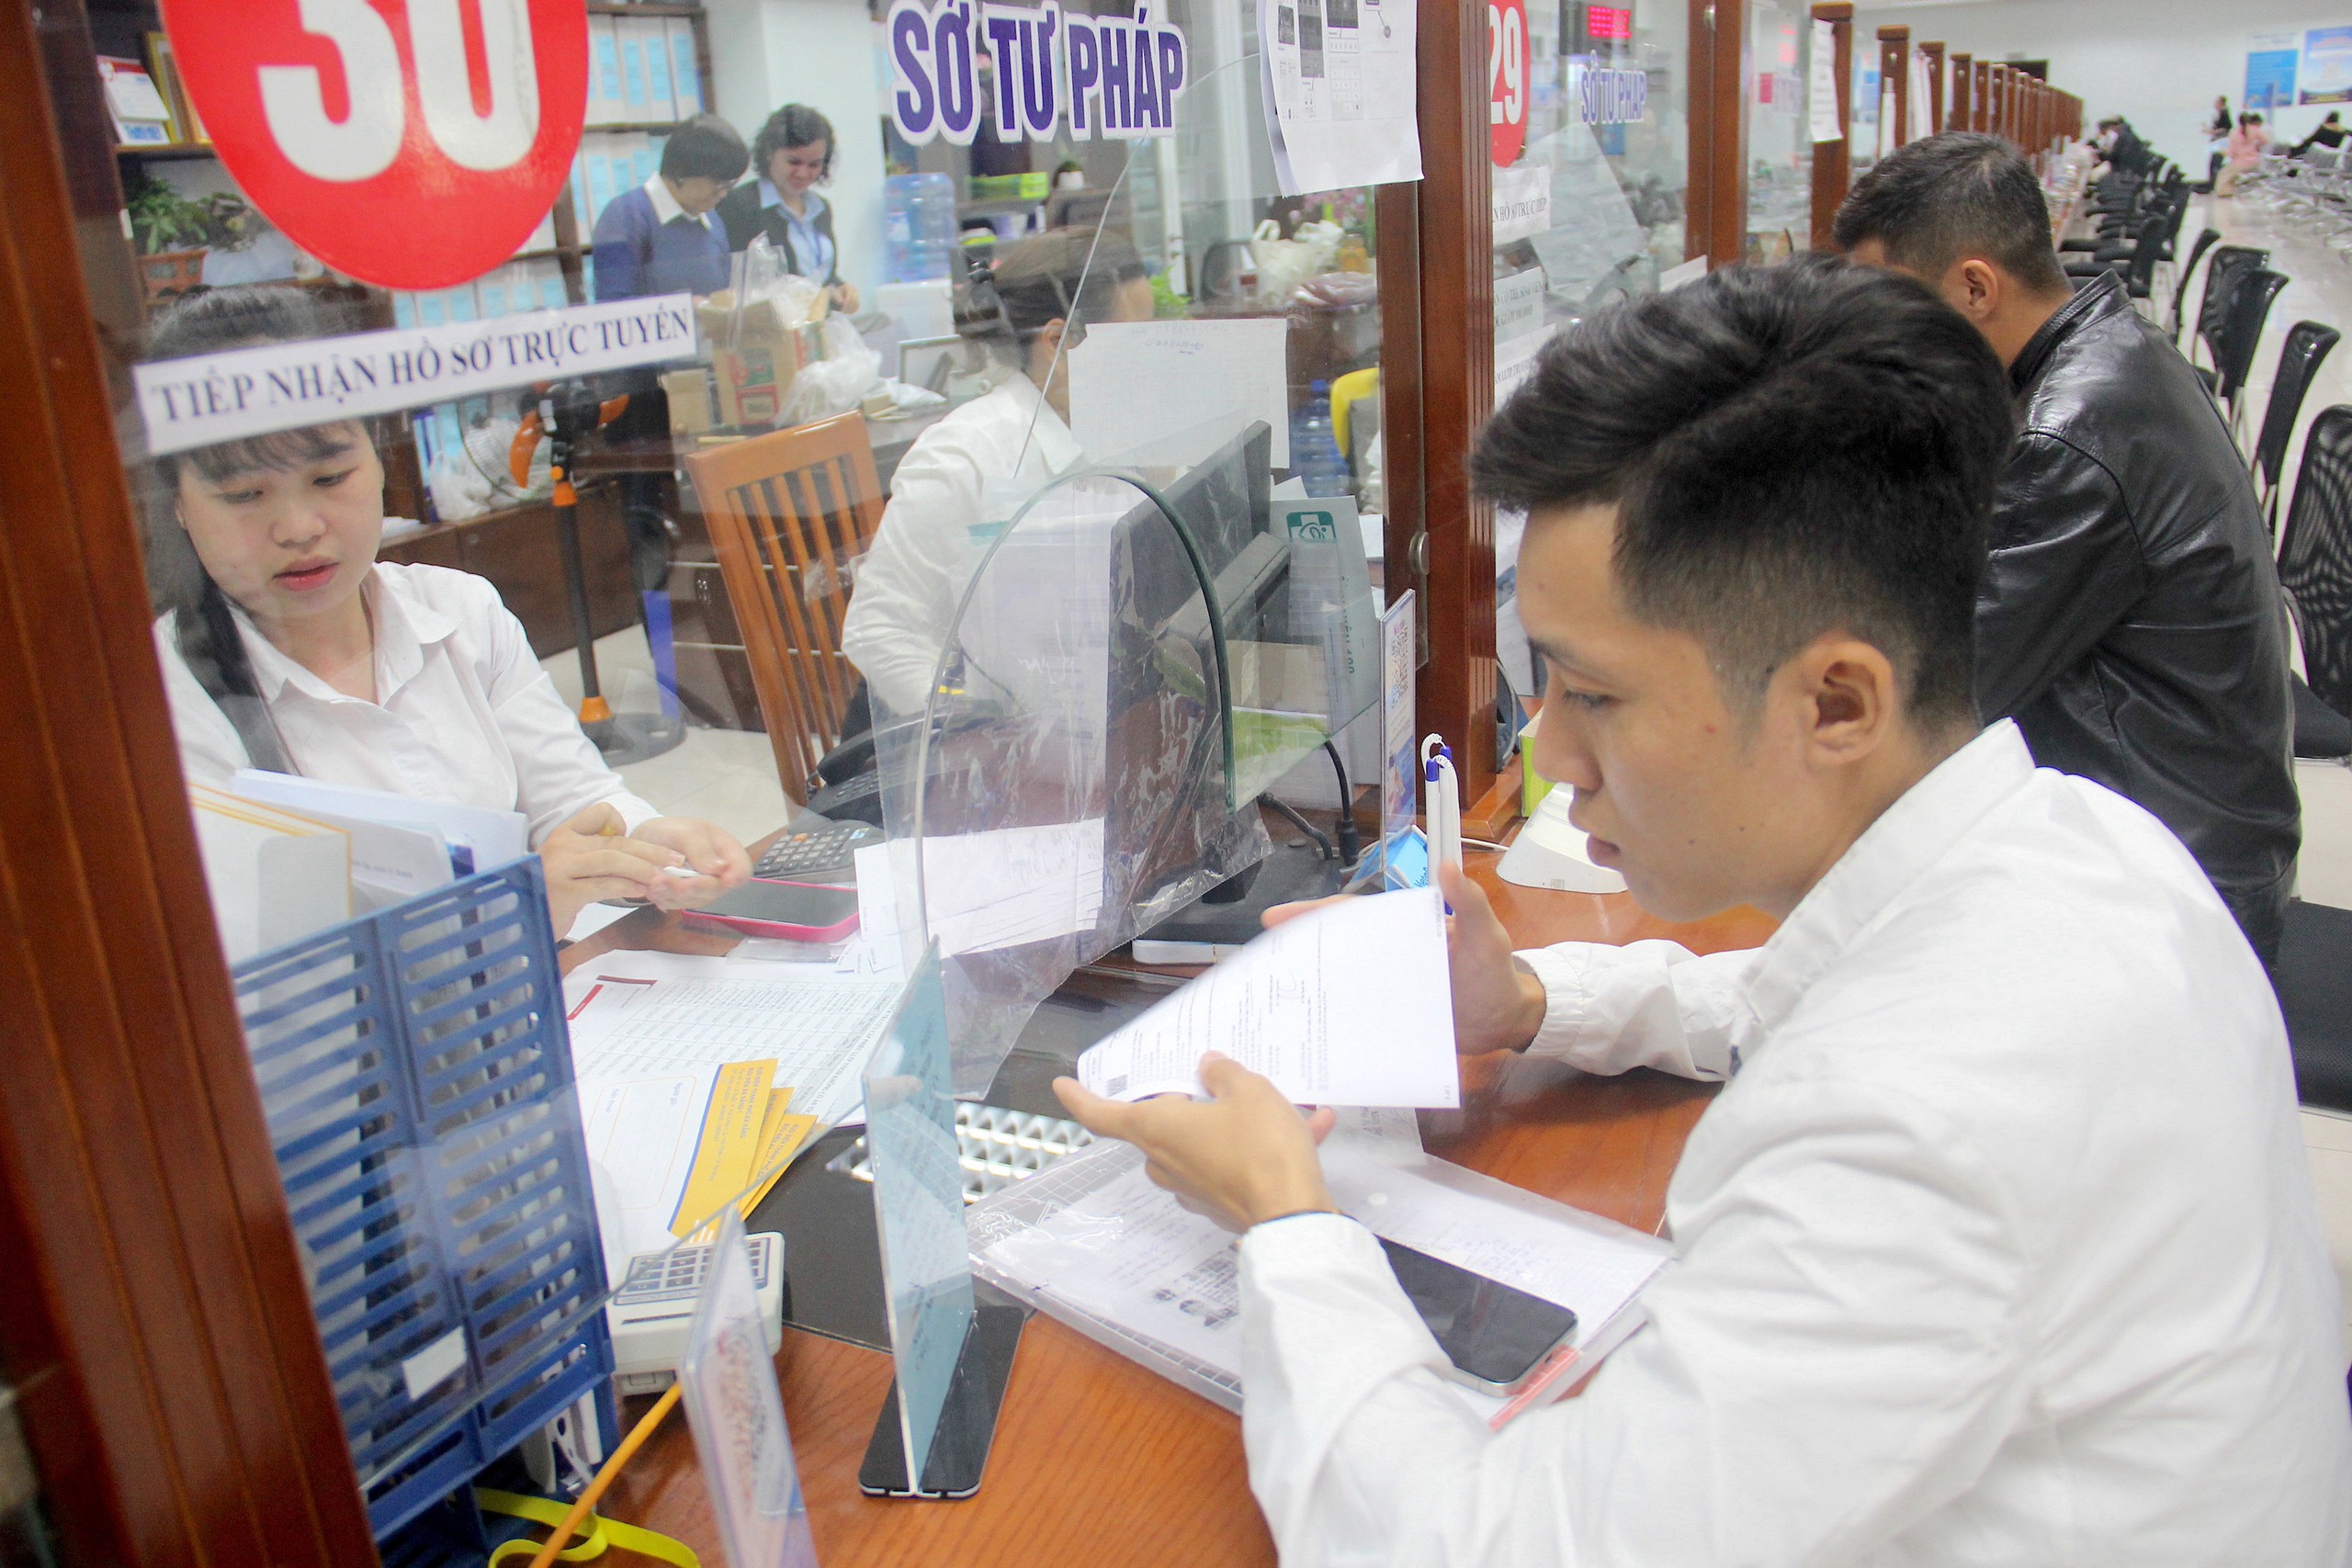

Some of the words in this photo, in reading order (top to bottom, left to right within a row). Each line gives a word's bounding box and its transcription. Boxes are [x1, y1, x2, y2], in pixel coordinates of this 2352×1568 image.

[893, 0, 973, 132] SỞ
[988, 10, 1055, 130] TƯ
[1069, 7, 1182, 129] PHÁP
[1489, 5, 1521, 124] 29
[152, 365, 254, 421] TIẾP
[266, 355, 378, 406] NHẬN
[390, 337, 440, 384] HỒ
[452, 335, 492, 375] SƠ
[499, 321, 587, 367] TRỰC
[596, 303, 689, 350] TUYẾN
